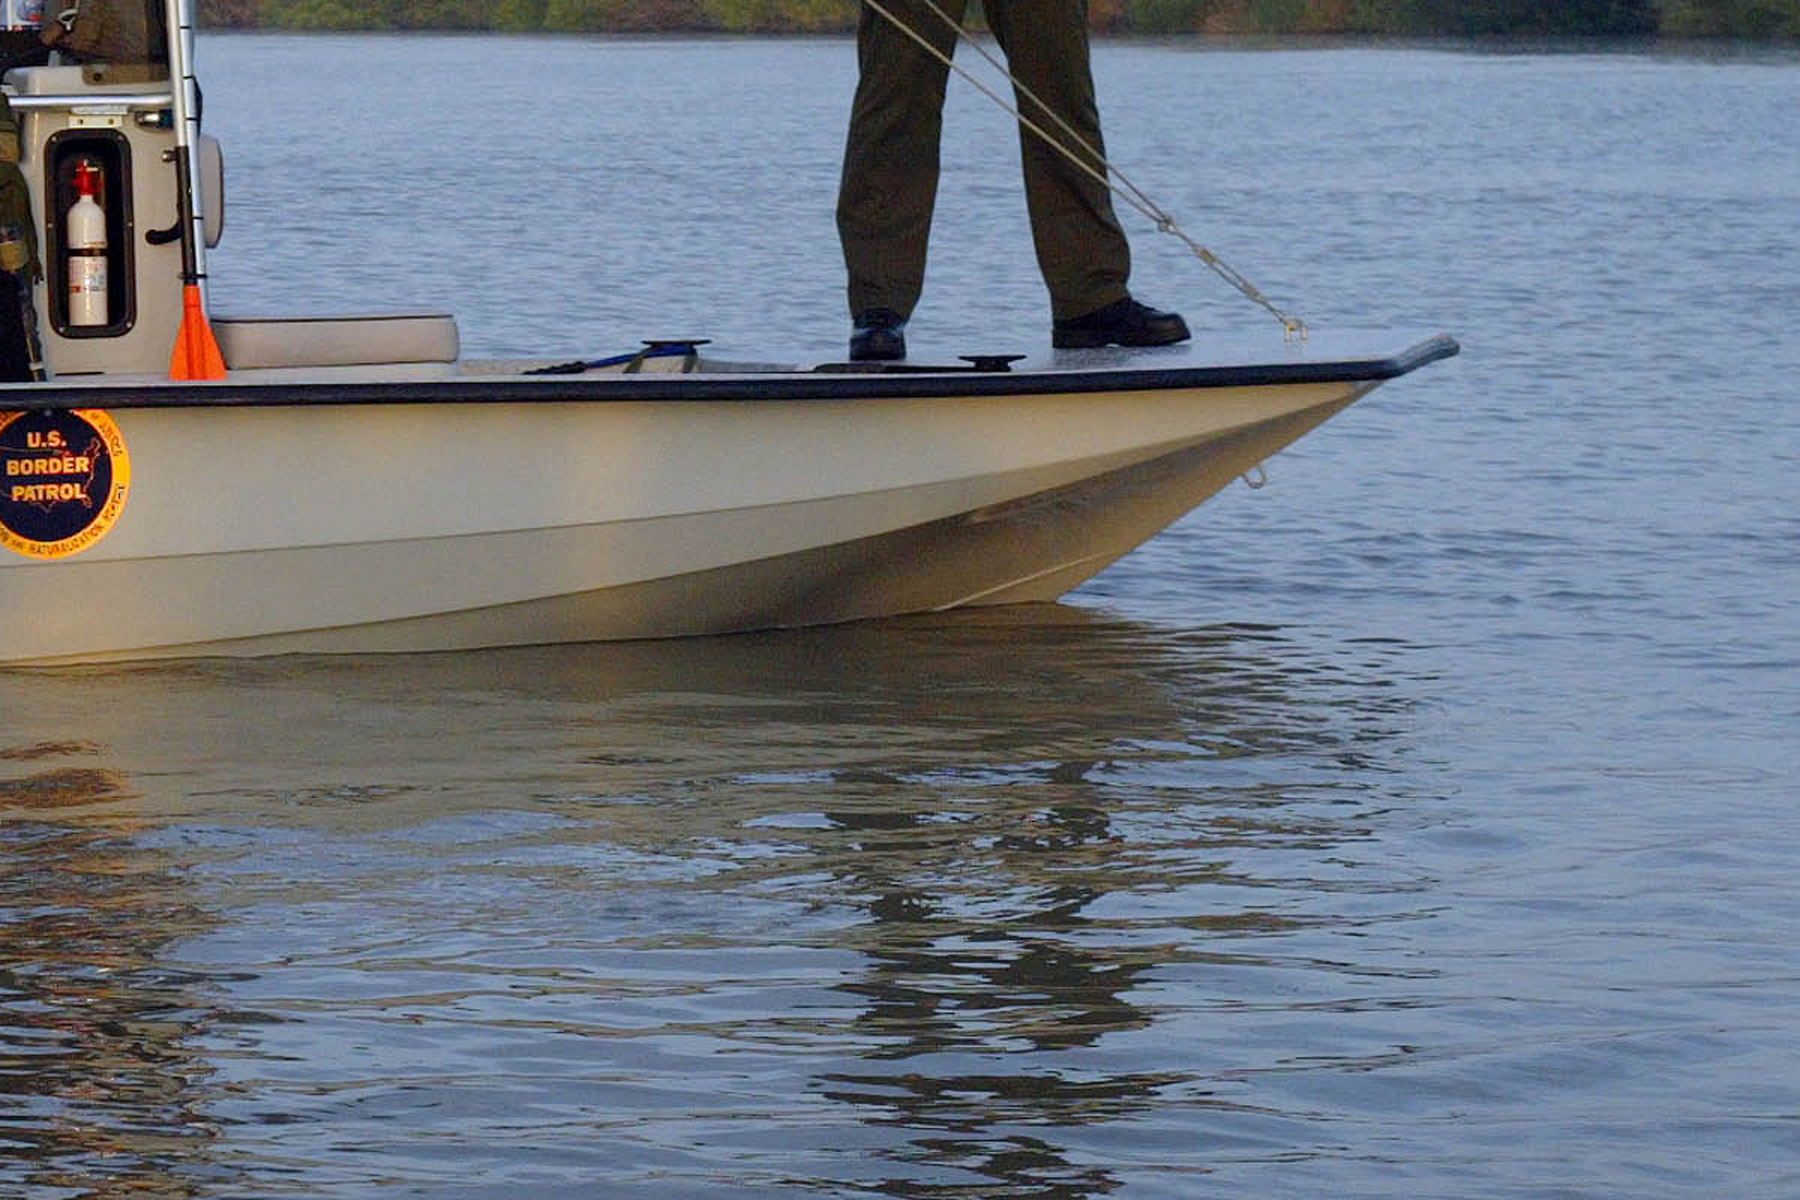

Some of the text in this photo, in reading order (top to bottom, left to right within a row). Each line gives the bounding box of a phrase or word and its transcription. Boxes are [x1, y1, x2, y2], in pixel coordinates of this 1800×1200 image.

[26, 430, 67, 448] U.S.
[6, 456, 90, 476] BORDER
[11, 483, 88, 502] PATROL
